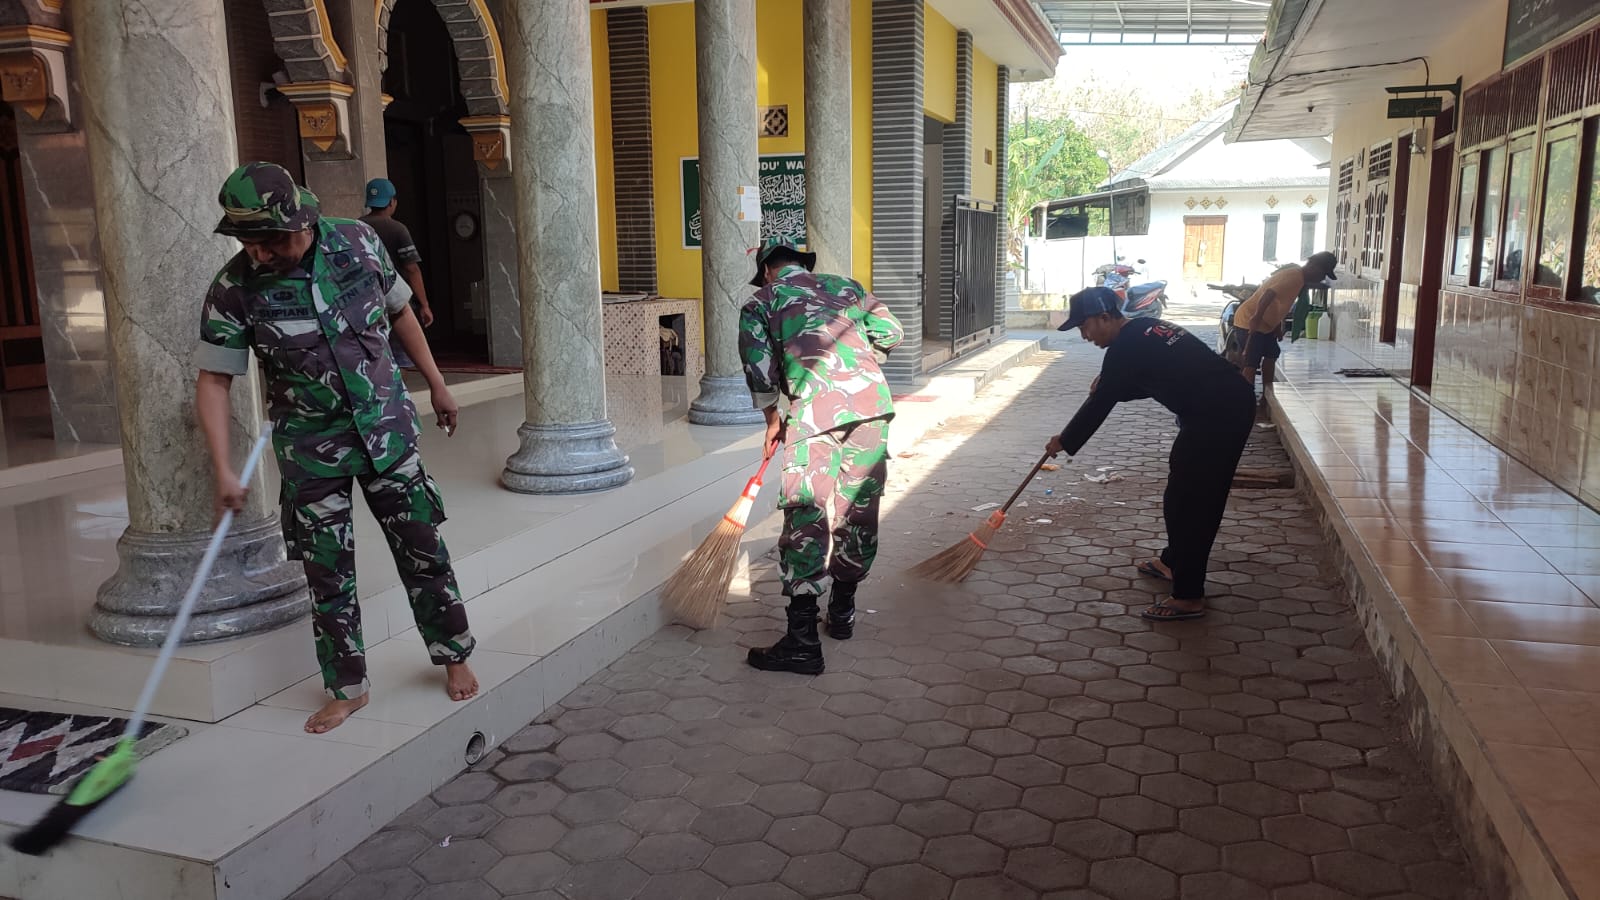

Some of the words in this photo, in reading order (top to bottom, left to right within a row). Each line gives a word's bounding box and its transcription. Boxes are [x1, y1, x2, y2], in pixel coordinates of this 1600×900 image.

[759, 161, 780, 171] DU'
[786, 161, 806, 170] WA
[339, 287, 360, 303] TNI
[259, 307, 309, 318] SUPIANI
